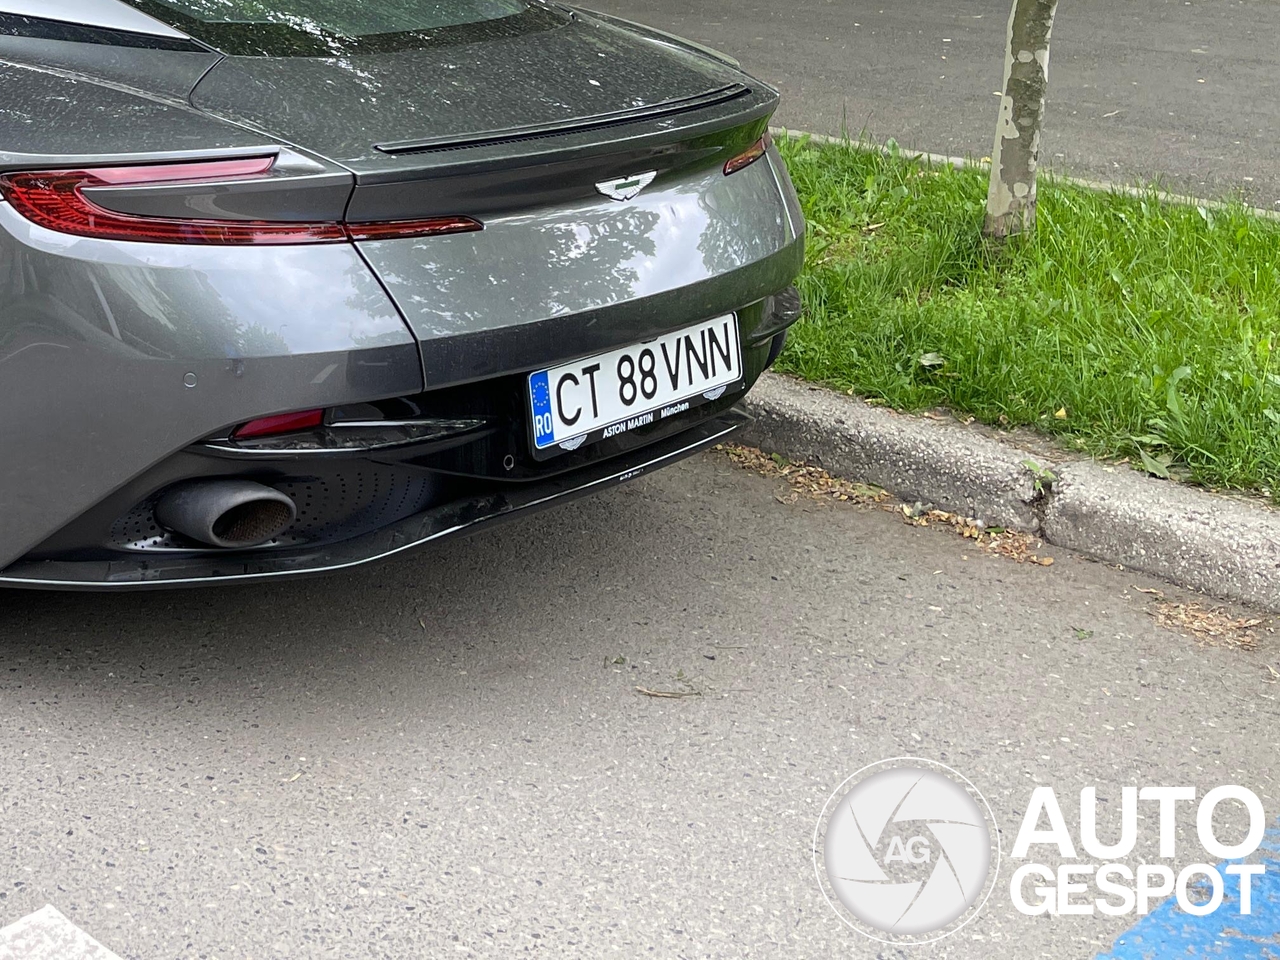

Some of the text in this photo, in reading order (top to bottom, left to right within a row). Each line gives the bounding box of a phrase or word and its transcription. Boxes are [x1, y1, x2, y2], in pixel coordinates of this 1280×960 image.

[555, 363, 601, 426] CT
[535, 412, 552, 438] RO
[602, 401, 689, 439] ASTON MARTIN München
